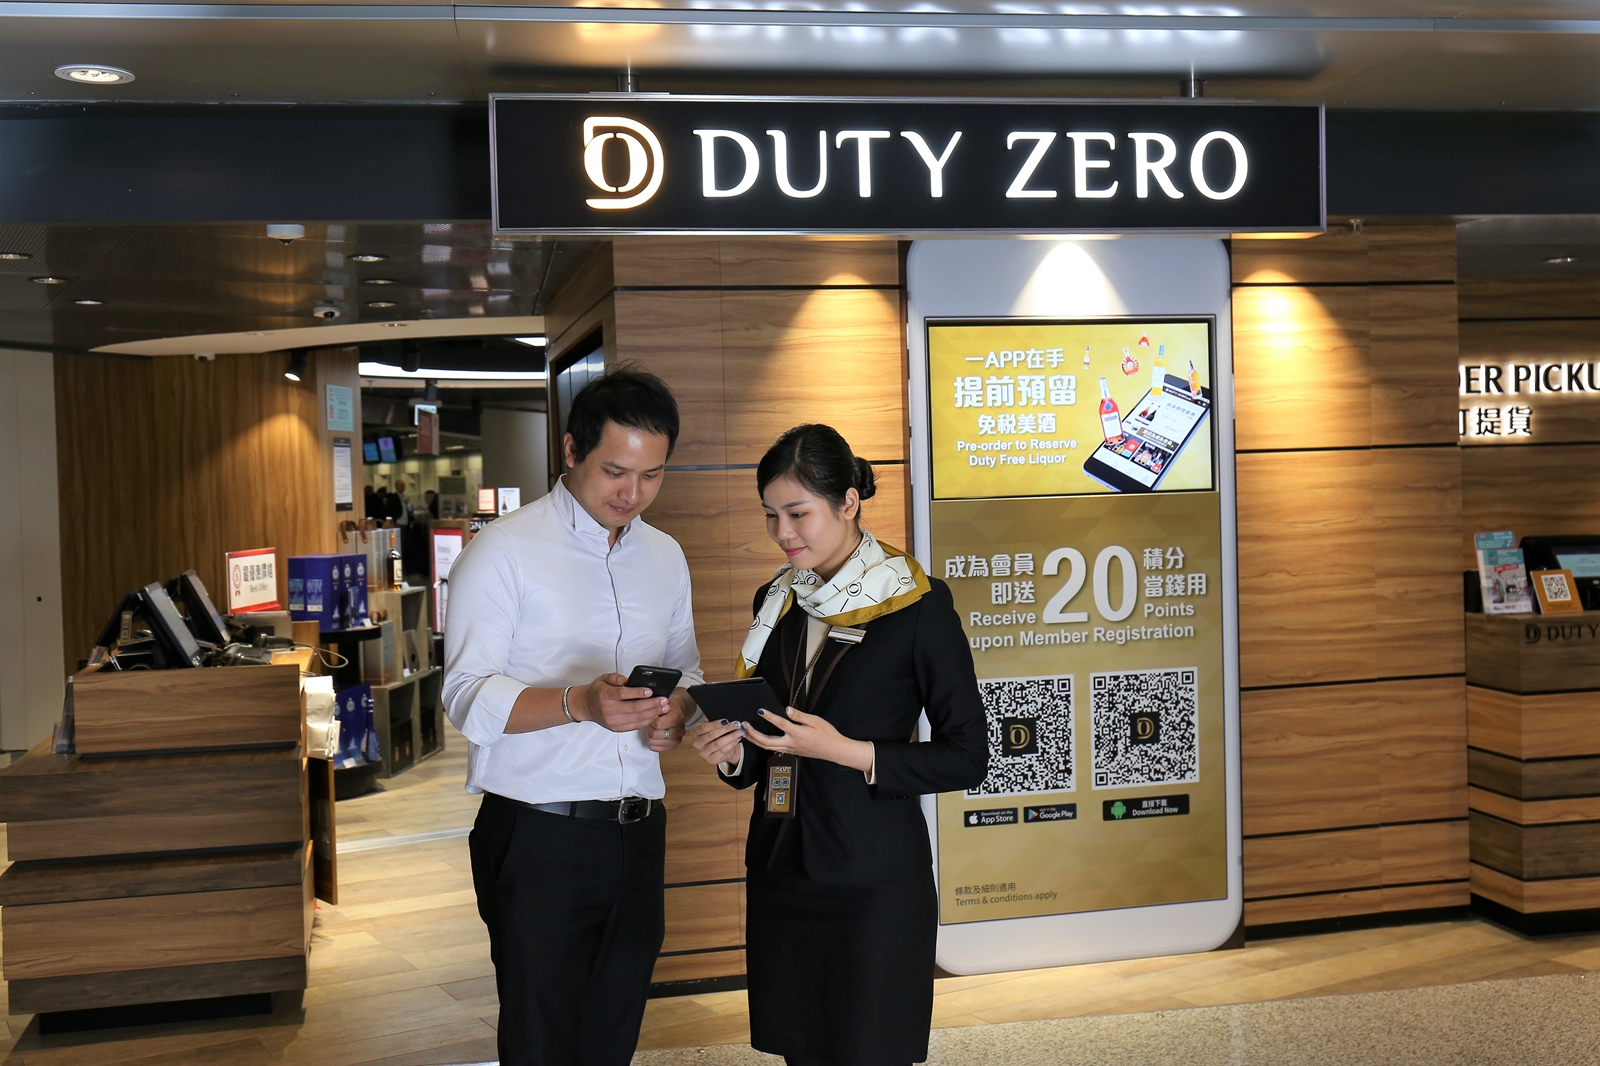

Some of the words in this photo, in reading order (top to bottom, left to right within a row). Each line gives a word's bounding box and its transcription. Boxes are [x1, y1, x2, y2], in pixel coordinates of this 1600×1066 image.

[692, 127, 965, 199] DUTY
[1004, 129, 1249, 201] ZERO
[965, 347, 1065, 369] 一APP在手
[1459, 364, 1504, 394] ER
[953, 374, 1077, 408] 提前預留
[957, 440, 1012, 452] Pre-order
[1015, 440, 1027, 450] to
[1030, 438, 1077, 450] Reserve
[969, 455, 996, 468] Duty
[1000, 454, 1025, 465] Free
[1029, 453, 1067, 467] Liquor
[944, 552, 1035, 579] 成為會員
[1143, 546, 1185, 571] 積分
[991, 581, 1036, 605] 即送
[1042, 545, 1138, 624] 20
[1144, 573, 1207, 597] 當錢用
[970, 610, 1036, 627] Receive
[1144, 602, 1195, 618] Points
[970, 633, 1014, 652] upon
[1020, 629, 1089, 647] Member
[1093, 623, 1195, 645] Registration
[1547, 624, 1599, 641] DUTY
[981, 816, 995, 824] App
[1039, 811, 1060, 820] Google
[1061, 810, 1073, 818] Play
[1132, 807, 1163, 816] Download
[955, 898, 981, 906] Terms
[982, 896, 988, 904] &
[990, 893, 1033, 904] conditions
[1034, 890, 1058, 901] apply
